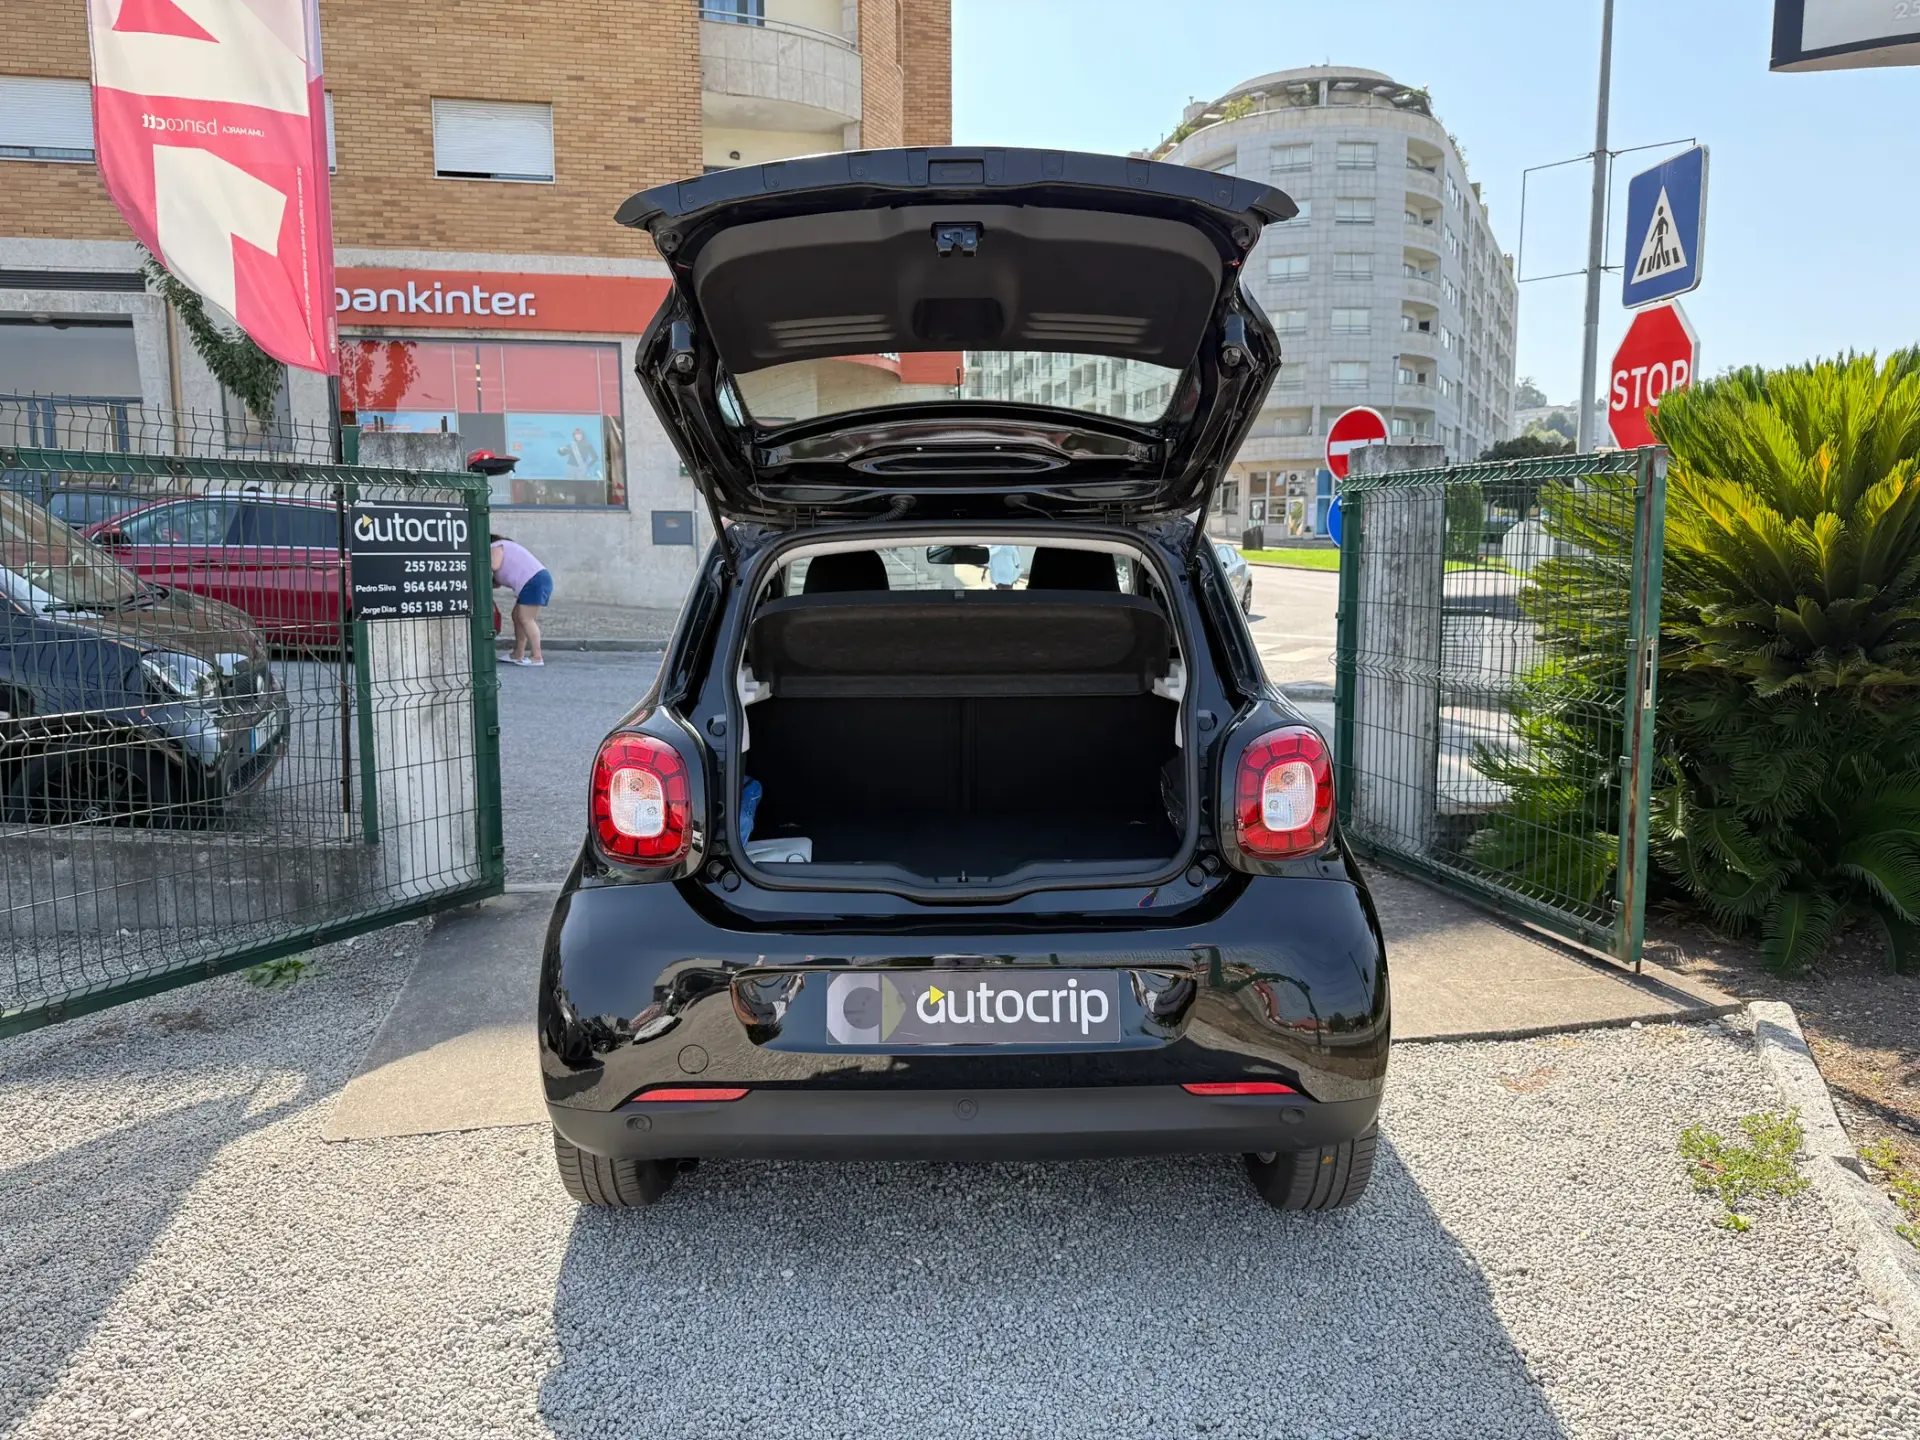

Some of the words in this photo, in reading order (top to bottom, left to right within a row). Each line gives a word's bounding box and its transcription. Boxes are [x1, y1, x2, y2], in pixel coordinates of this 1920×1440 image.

[1611, 359, 1689, 412] STOP
[354, 511, 468, 551] autocrip
[404, 560, 426, 573] 255
[427, 560, 448, 572] 782
[448, 560, 467, 572] 236
[355, 584, 378, 593] Pedro
[377, 583, 397, 593] Silva
[403, 581, 426, 593] 964
[427, 580, 448, 593] 644
[448, 580, 468, 592] 794
[360, 606, 381, 616] Jorge
[380, 605, 397, 614] Dias
[400, 602, 423, 614] 965
[424, 601, 444, 613] 138
[449, 599, 469, 612] 214
[916, 978, 1109, 1035] autocrip
